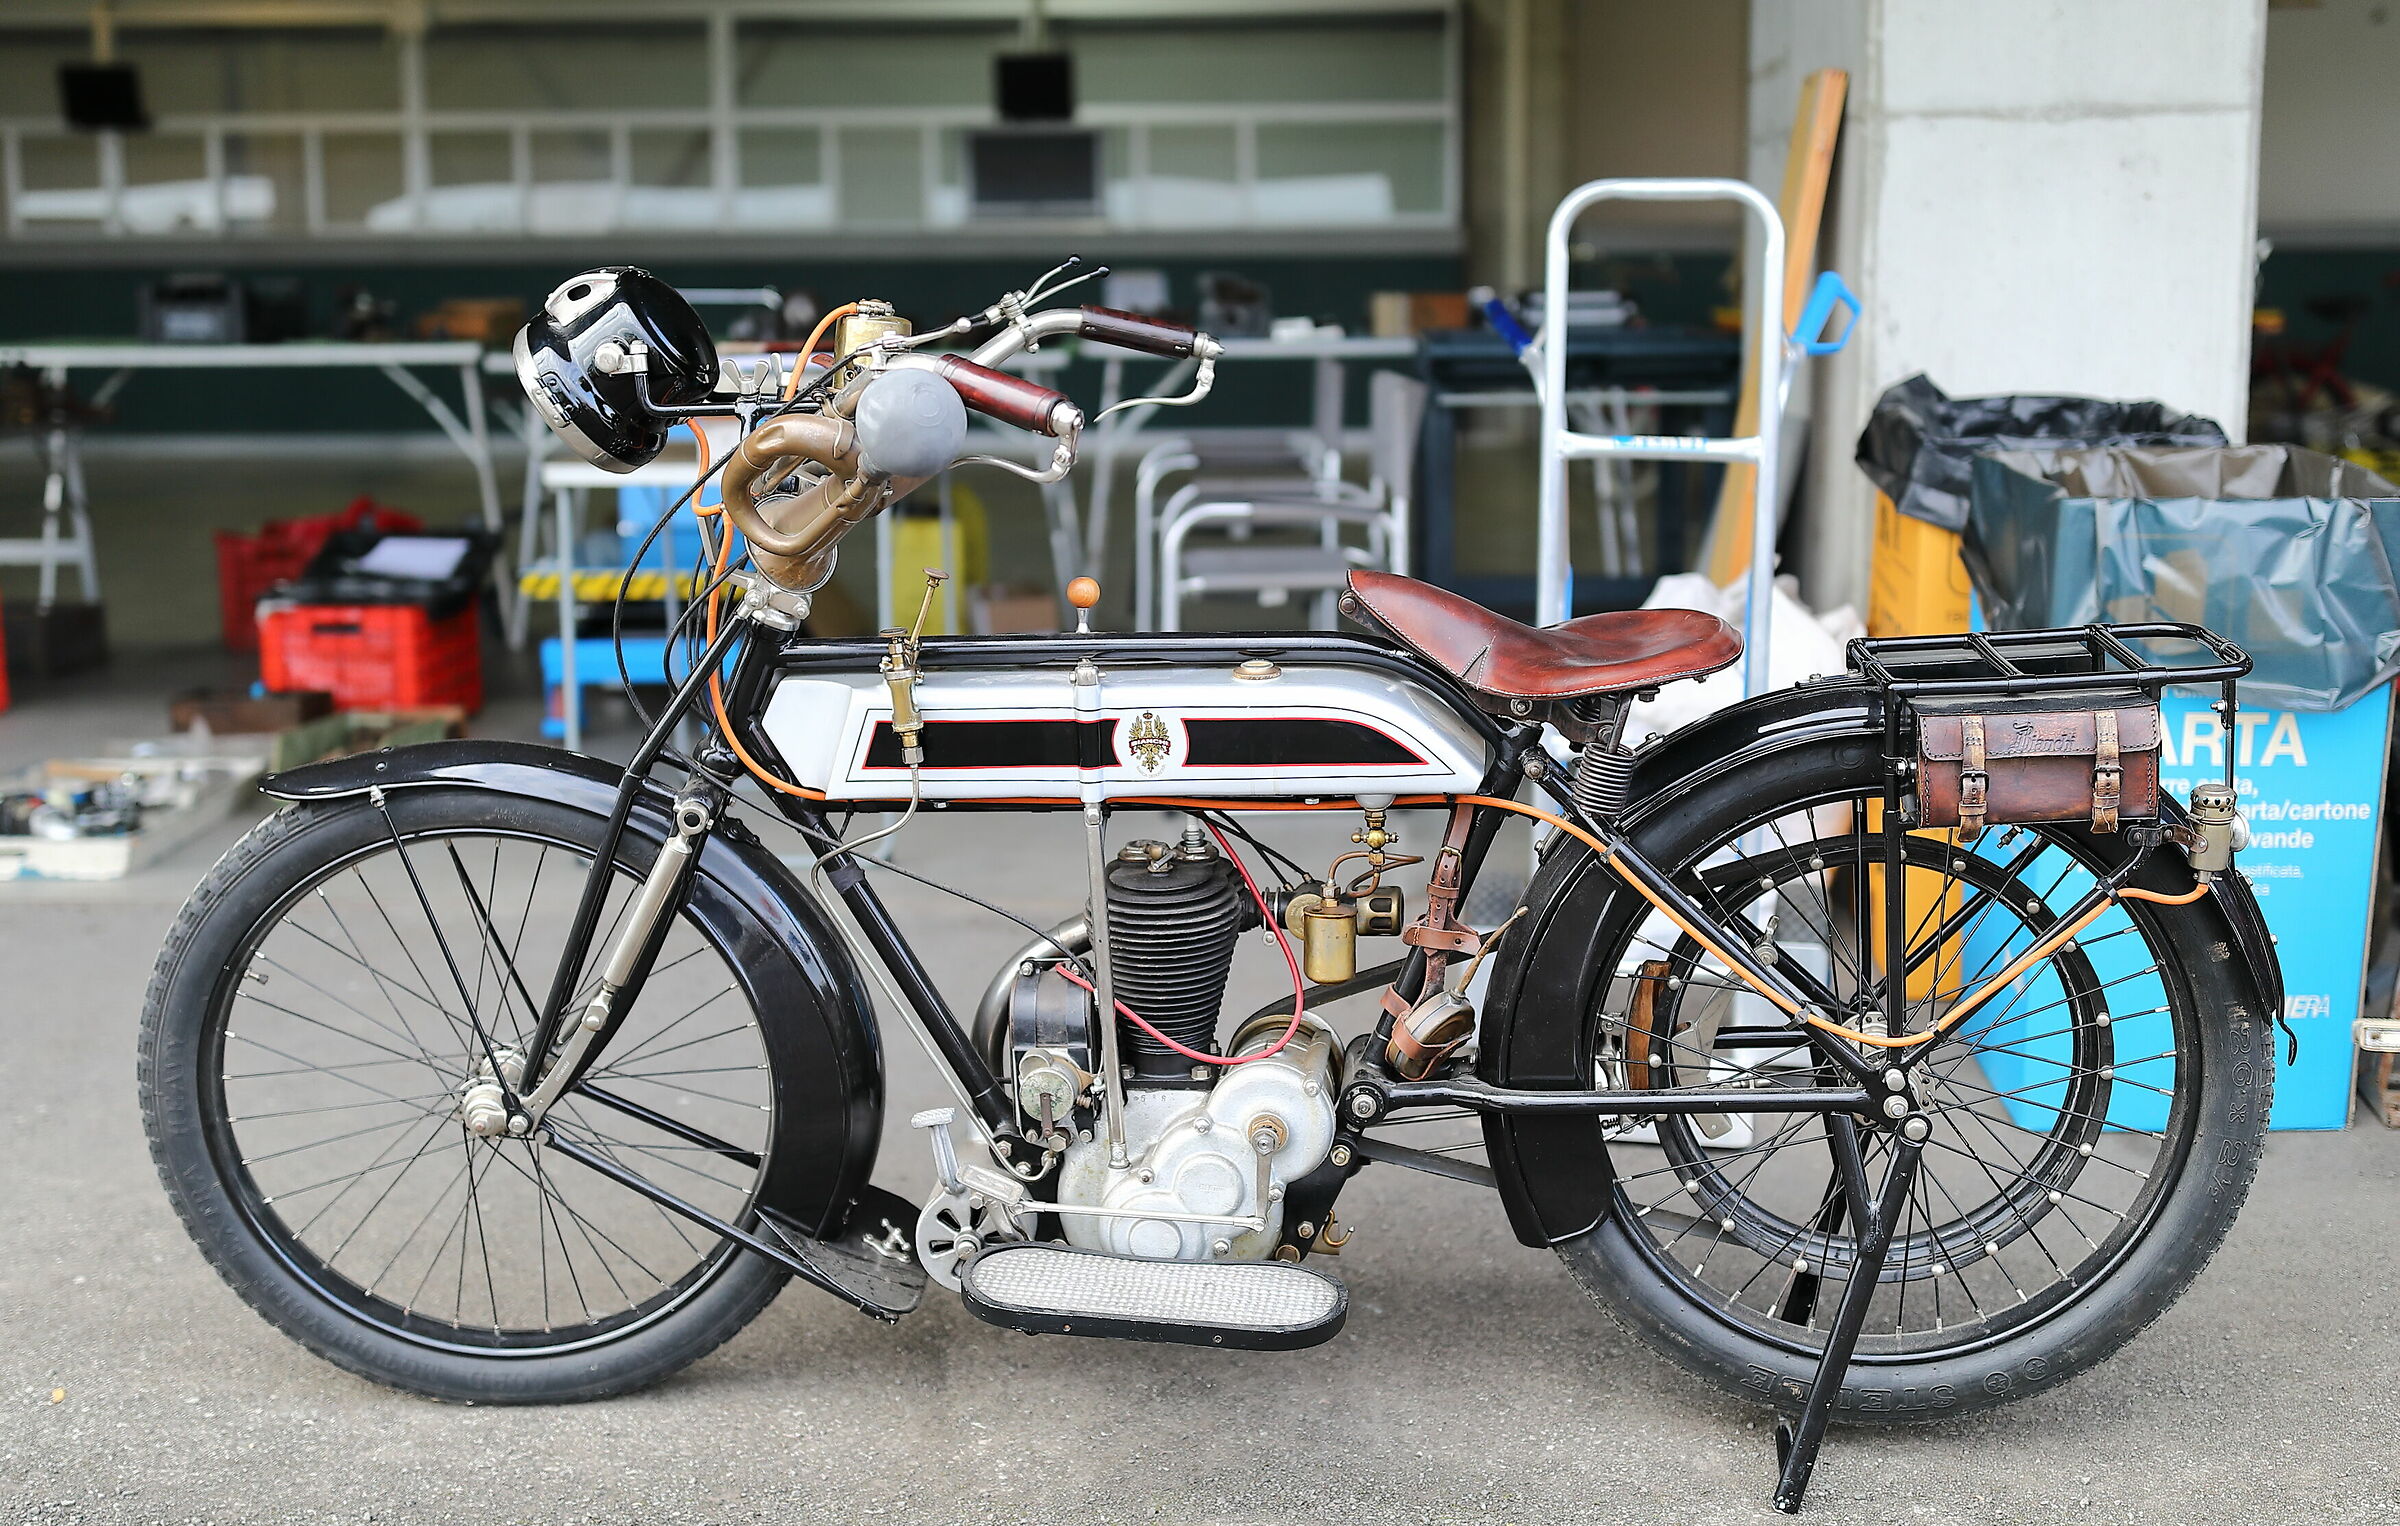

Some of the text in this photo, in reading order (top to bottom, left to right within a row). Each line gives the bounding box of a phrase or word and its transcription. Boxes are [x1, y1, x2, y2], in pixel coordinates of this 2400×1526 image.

[1130, 738, 1169, 747] BIANCHI
[2009, 721, 2077, 753] Bianchi
[2160, 711, 2308, 768] ARTA
[2237, 800, 2371, 821] arta/cartone
[2249, 828, 2314, 849] vande
